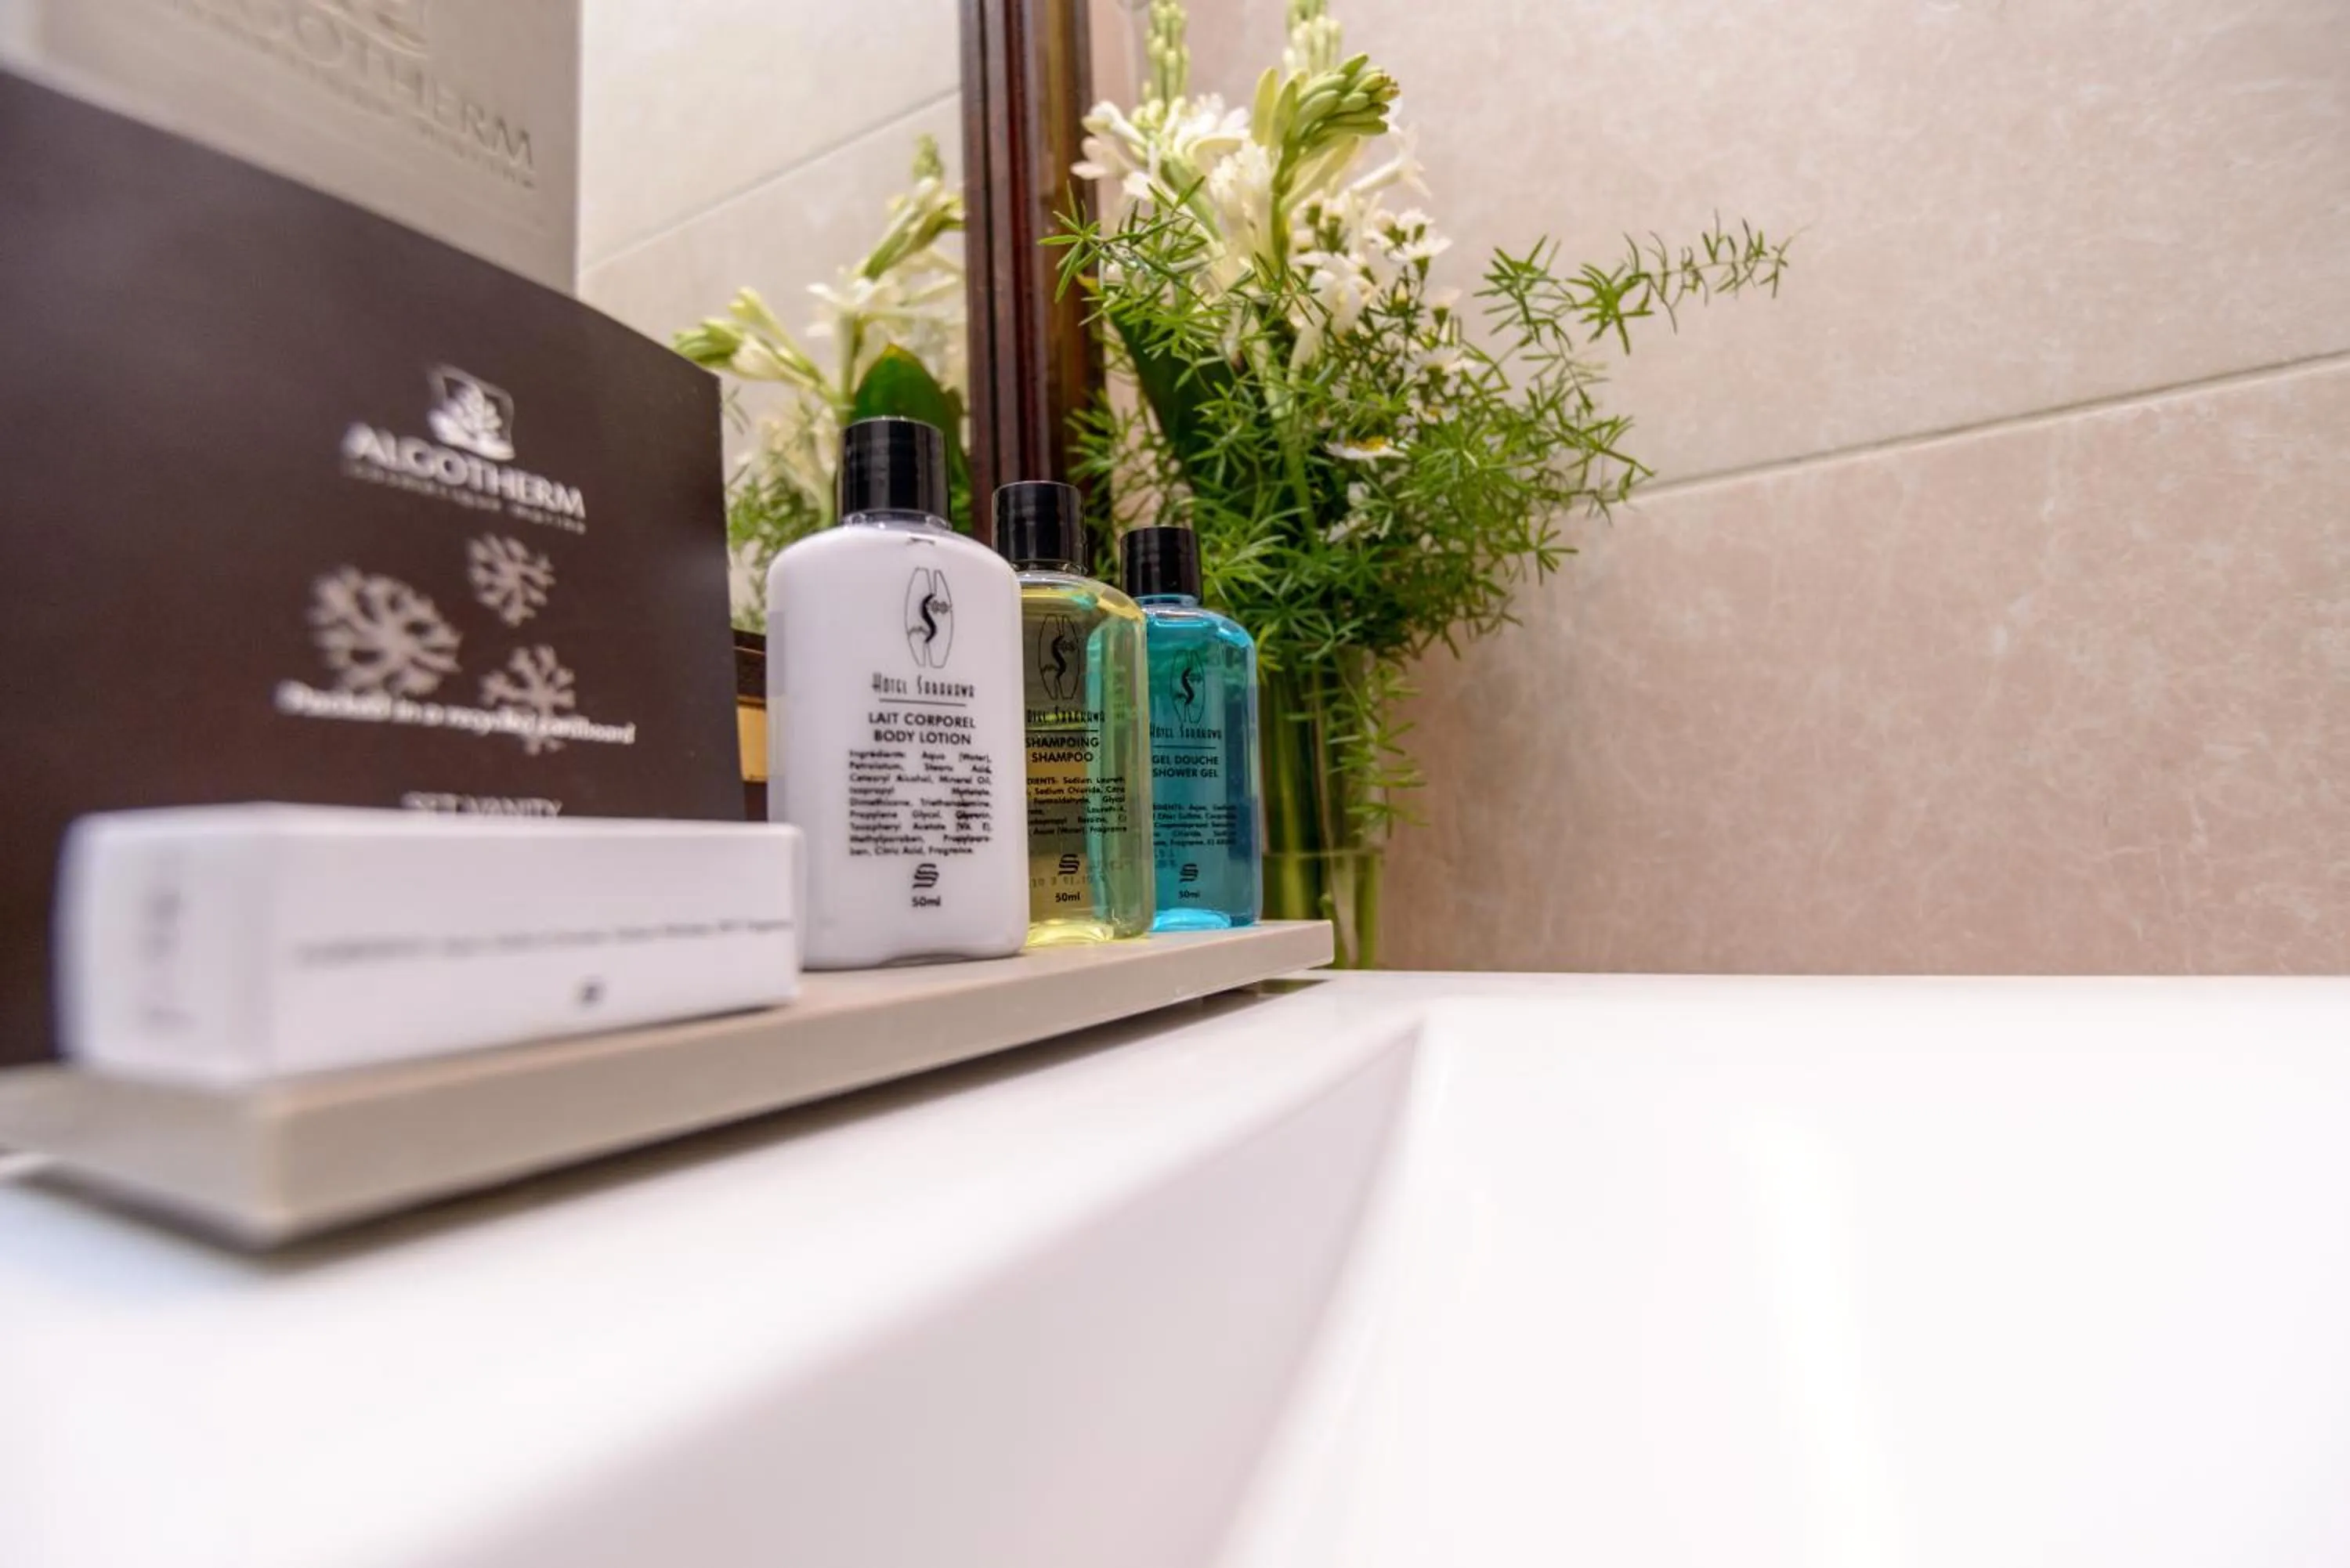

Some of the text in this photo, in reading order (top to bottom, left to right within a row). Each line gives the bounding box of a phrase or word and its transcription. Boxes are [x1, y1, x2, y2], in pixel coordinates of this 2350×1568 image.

[341, 421, 586, 519] ALGOTHERM
[871, 672, 908, 694] HOTEL
[869, 713, 976, 728] LAIT CORPOREL
[1028, 710, 1047, 723] OTEL
[874, 730, 971, 745] BODY LOTION
[1025, 737, 1099, 748] SHAMPOING
[922, 751, 945, 761] Aqua
[1032, 752, 1094, 763] SHAMPOO
[1152, 755, 1219, 765] GEL DOUCHE
[1153, 768, 1218, 778] SHOWER GEL
[1054, 892, 1080, 902] 50ml
[1179, 890, 1200, 898] 50ml
[912, 896, 941, 908] 50ml
